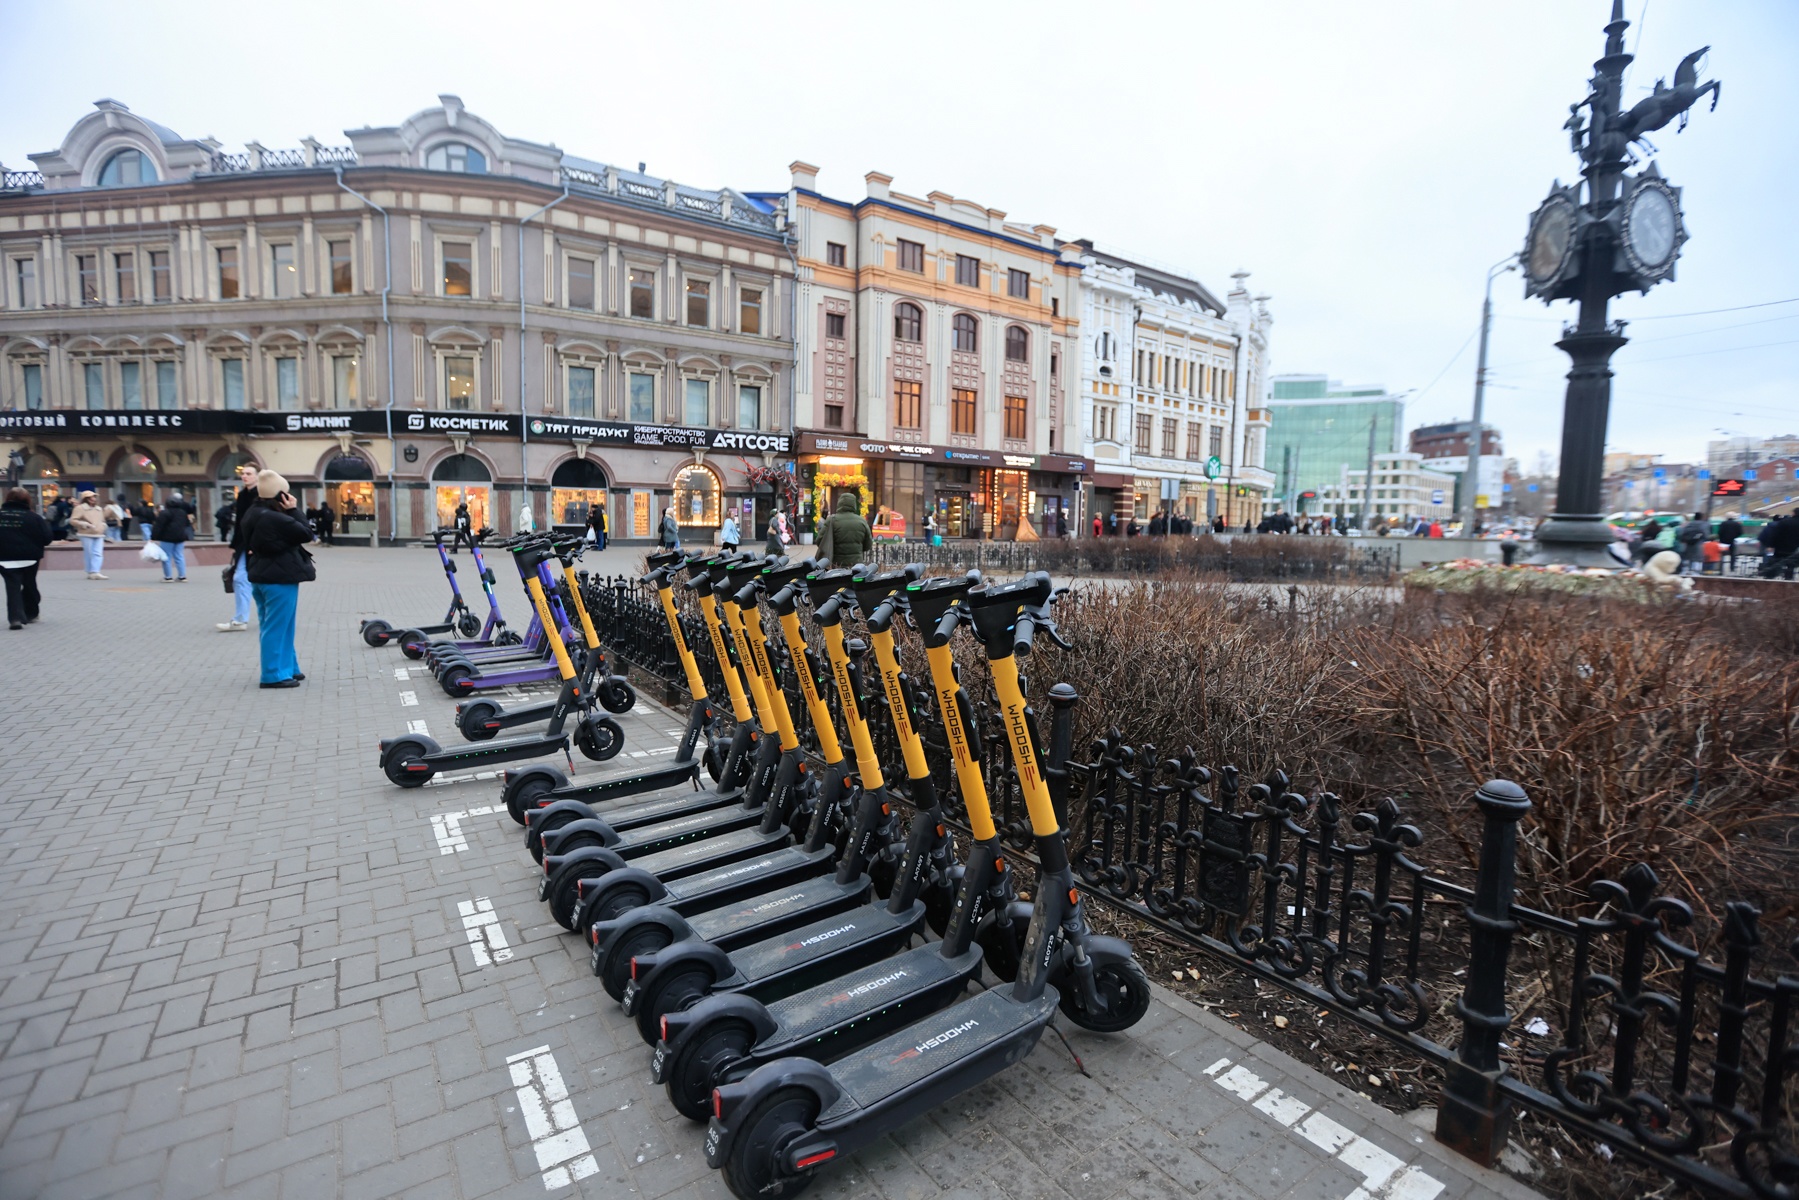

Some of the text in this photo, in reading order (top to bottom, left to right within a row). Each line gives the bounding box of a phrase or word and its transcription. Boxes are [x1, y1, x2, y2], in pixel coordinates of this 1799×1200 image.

[80, 415, 183, 427] КОМПЛЕКС
[302, 415, 352, 429] МАГНИТ
[429, 416, 509, 432] КОСМЕТИК
[572, 425, 630, 439] ПРОДУКТ
[634, 425, 706, 437] КИБЕРПРОСТРАНСТВО
[690, 437, 706, 445] FUN
[712, 432, 789, 452] ARTCORE
[860, 443, 885, 453] ФОТО
[538, 598, 553, 627] WHOOSH
[710, 623, 726, 659] WHOOSH
[735, 629, 750, 666] WHOOSH
[753, 639, 770, 680] WHOOSH
[793, 646, 812, 694] WHOOSH
[834, 661, 852, 707] WHOOSH
[885, 670, 905, 720] WHOOSH
[941, 689, 963, 745] WHOOSH
[1008, 704, 1033, 765] WHOOSH
[778, 785, 788, 808] AB2600
[670, 815, 713, 830] WHOOSH
[824, 802, 834, 826] AD2206
[684, 841, 730, 856] WHOOSH
[859, 832, 870, 855] AA3103
[727, 860, 773, 877] WHOOSH
[913, 854, 924, 882] AA7497
[752, 893, 805, 914] WHOOSH
[970, 894, 982, 924] AC3035
[800, 923, 857, 948] WHOOSH
[1043, 934, 1054, 968] AE0729
[847, 970, 907, 999] WHOOSH
[915, 1019, 980, 1054] WHOOSH
[706, 1138, 716, 1156] 729
[708, 1126, 719, 1145] AE0
